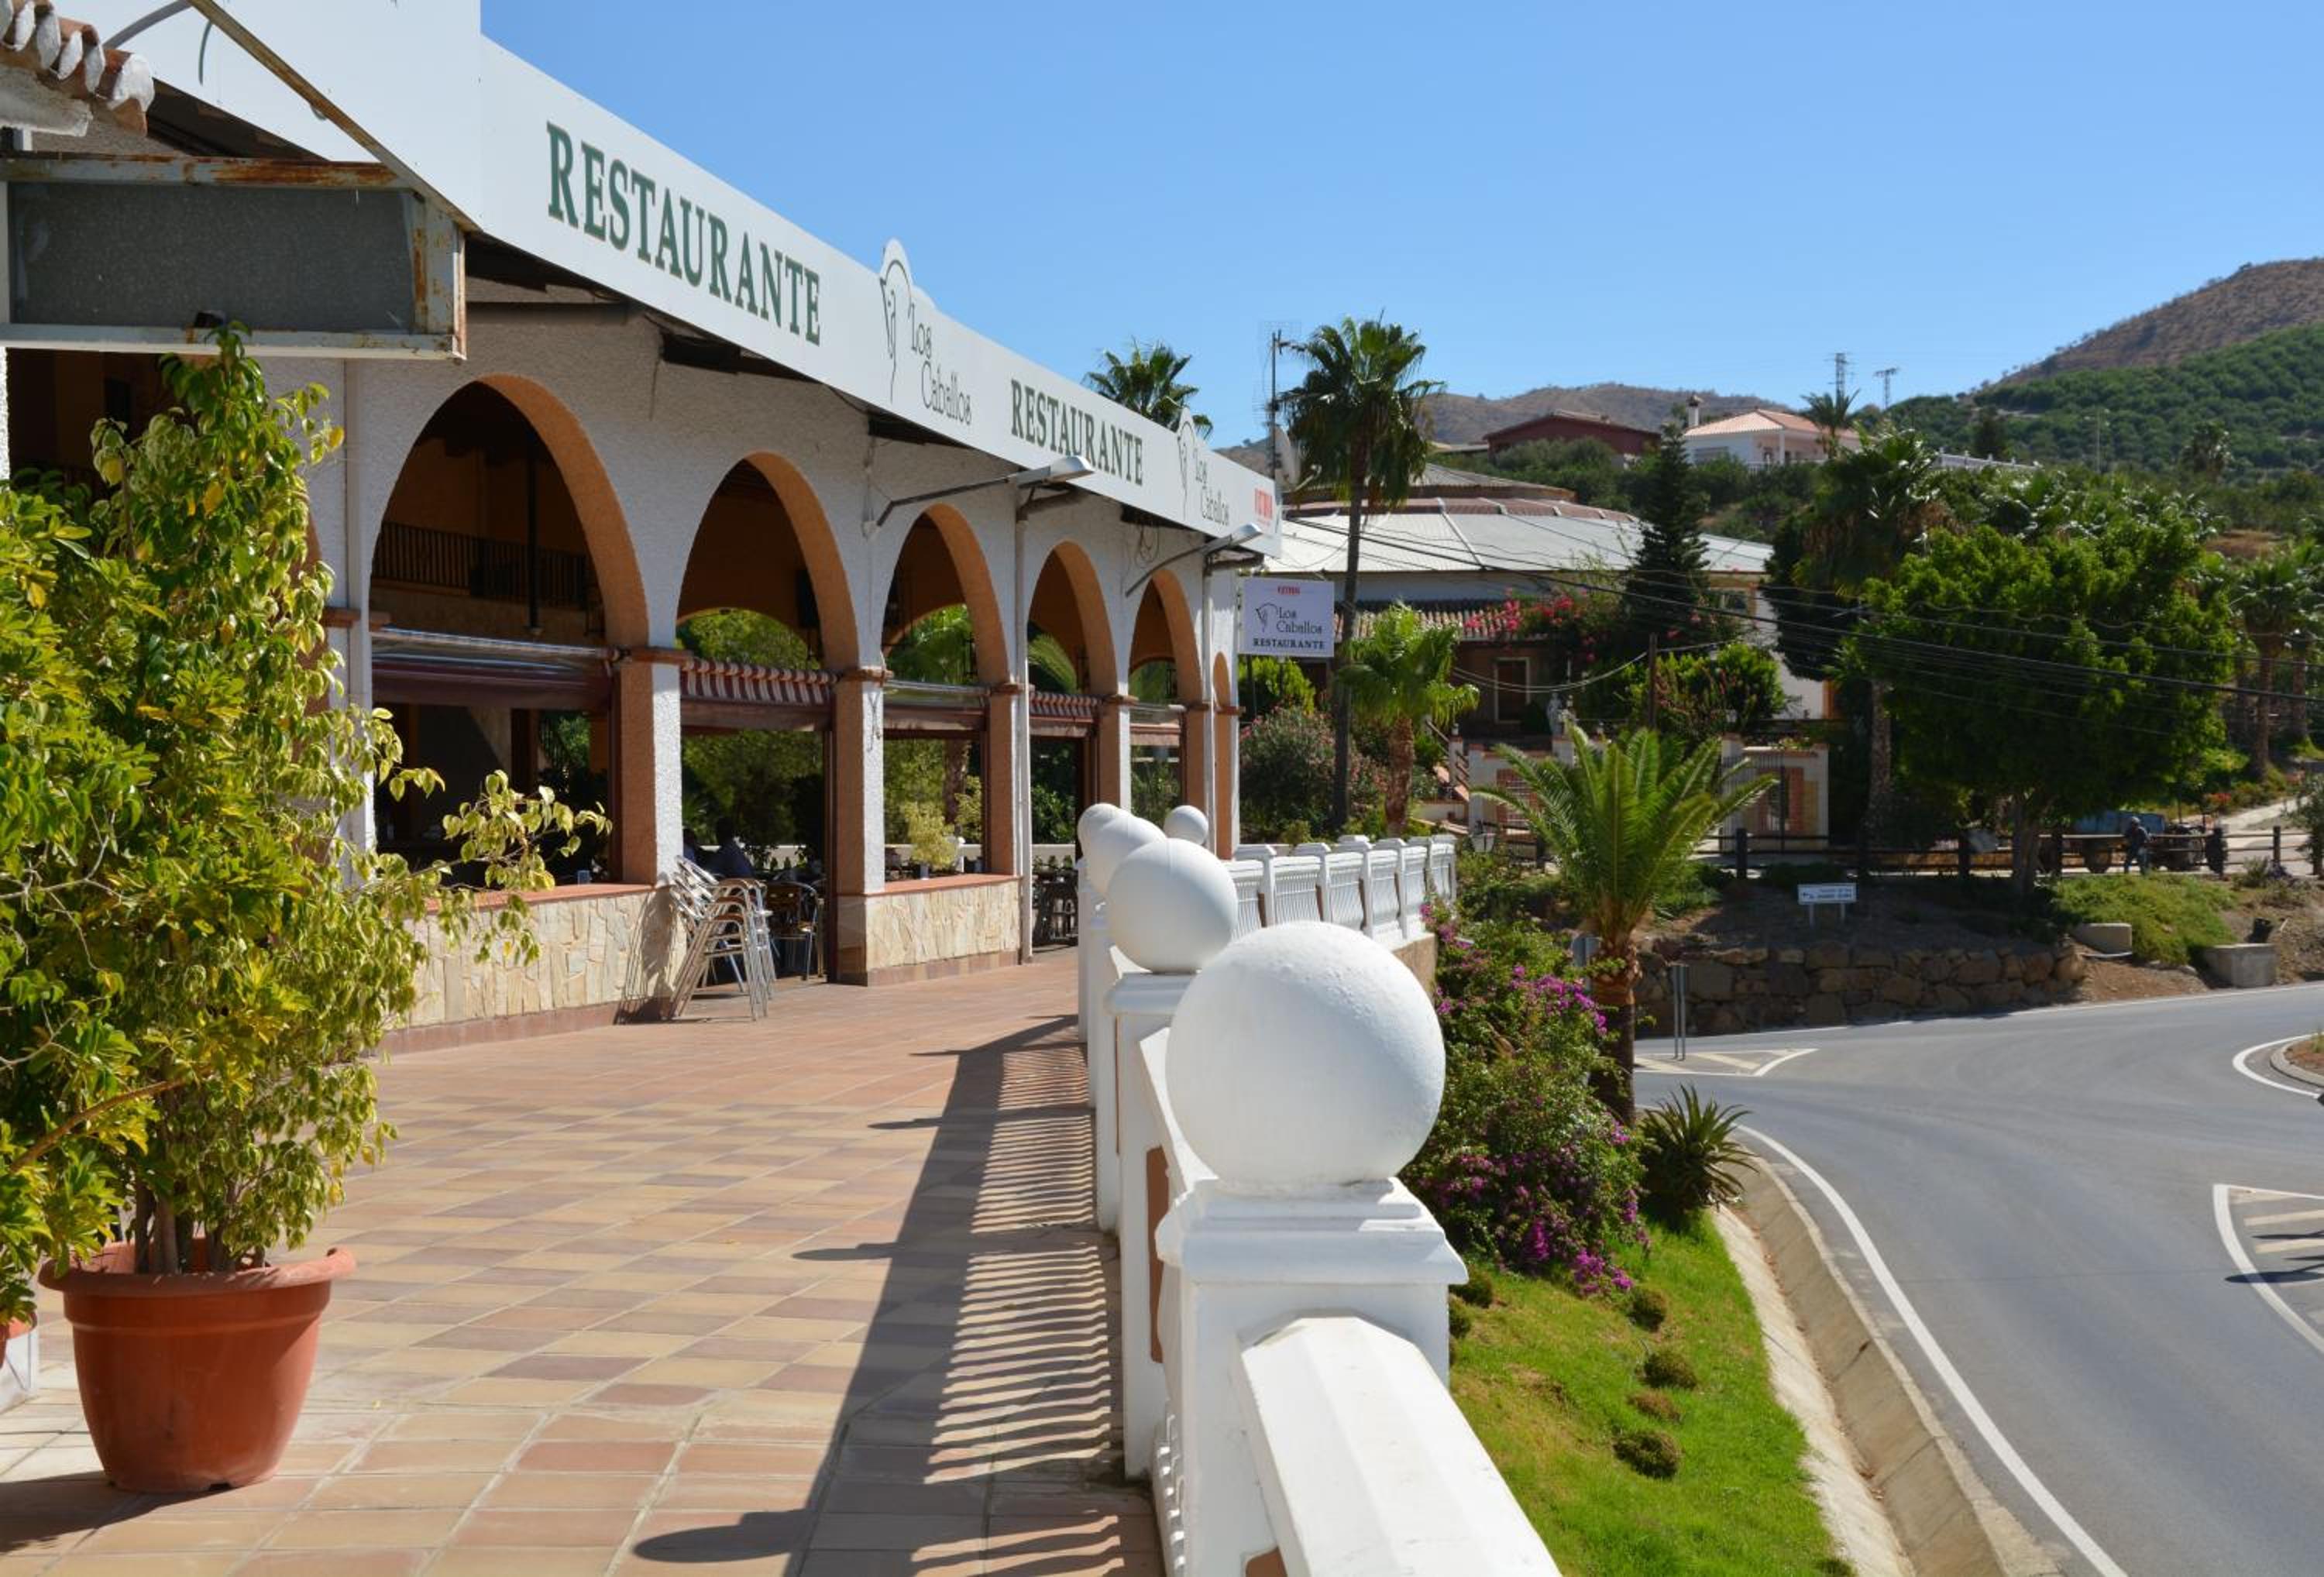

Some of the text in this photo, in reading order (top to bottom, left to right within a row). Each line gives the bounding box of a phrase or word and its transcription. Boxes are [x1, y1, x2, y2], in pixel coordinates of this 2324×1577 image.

[546, 120, 820, 347] RESTAURANTE
[910, 302, 932, 360] Los
[921, 360, 972, 425] Caballos
[1011, 378, 1143, 486] RESTAURANTE
[1276, 620, 1322, 634] Caballos
[1279, 606, 1297, 619] Los
[1253, 637, 1325, 650] RESTAURANTE
